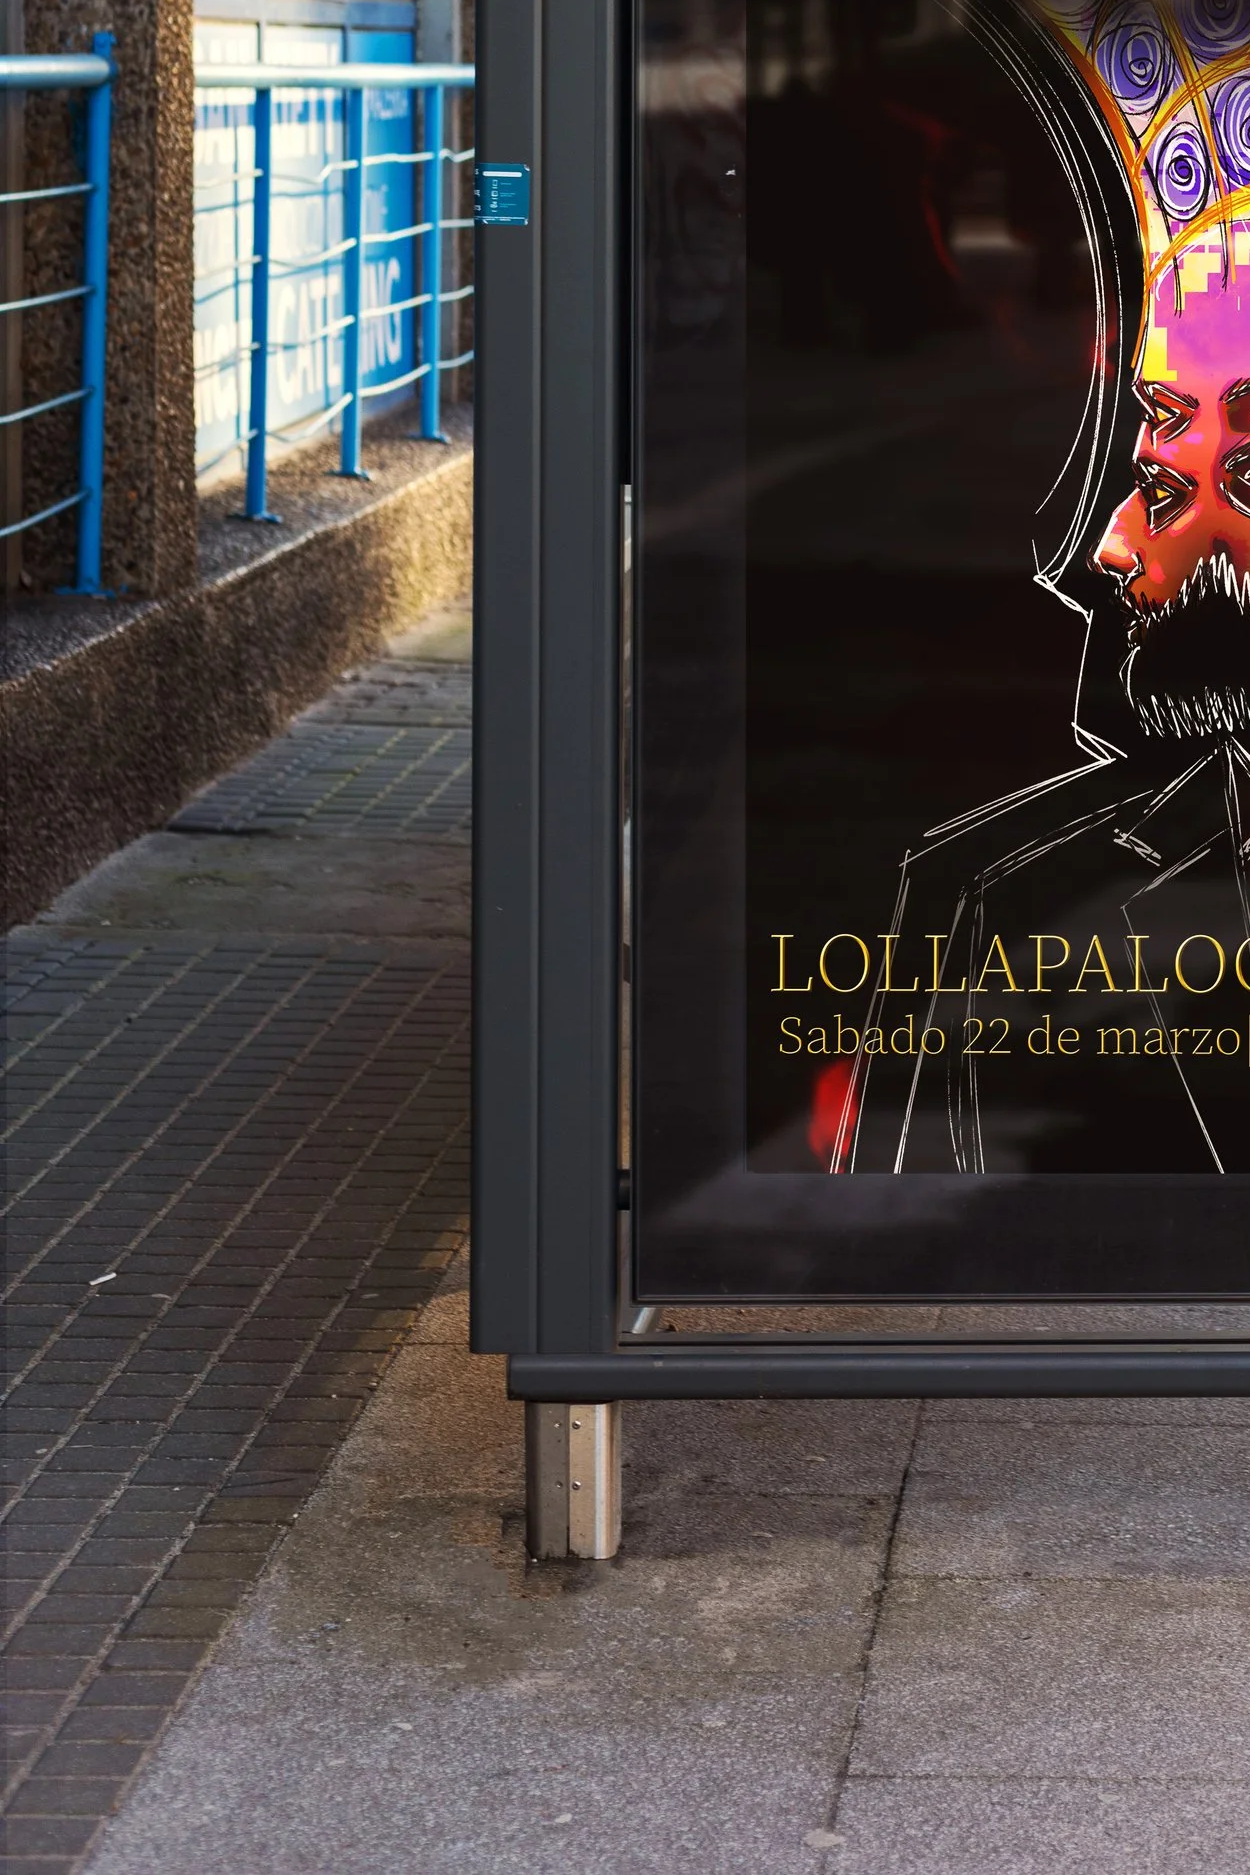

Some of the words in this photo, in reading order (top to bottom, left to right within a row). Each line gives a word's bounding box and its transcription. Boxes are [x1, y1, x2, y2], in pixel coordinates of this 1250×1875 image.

[276, 256, 401, 406] CATEING
[777, 1014, 945, 1056] Sabado
[961, 1017, 1012, 1056] 22
[1025, 1015, 1083, 1056] de
